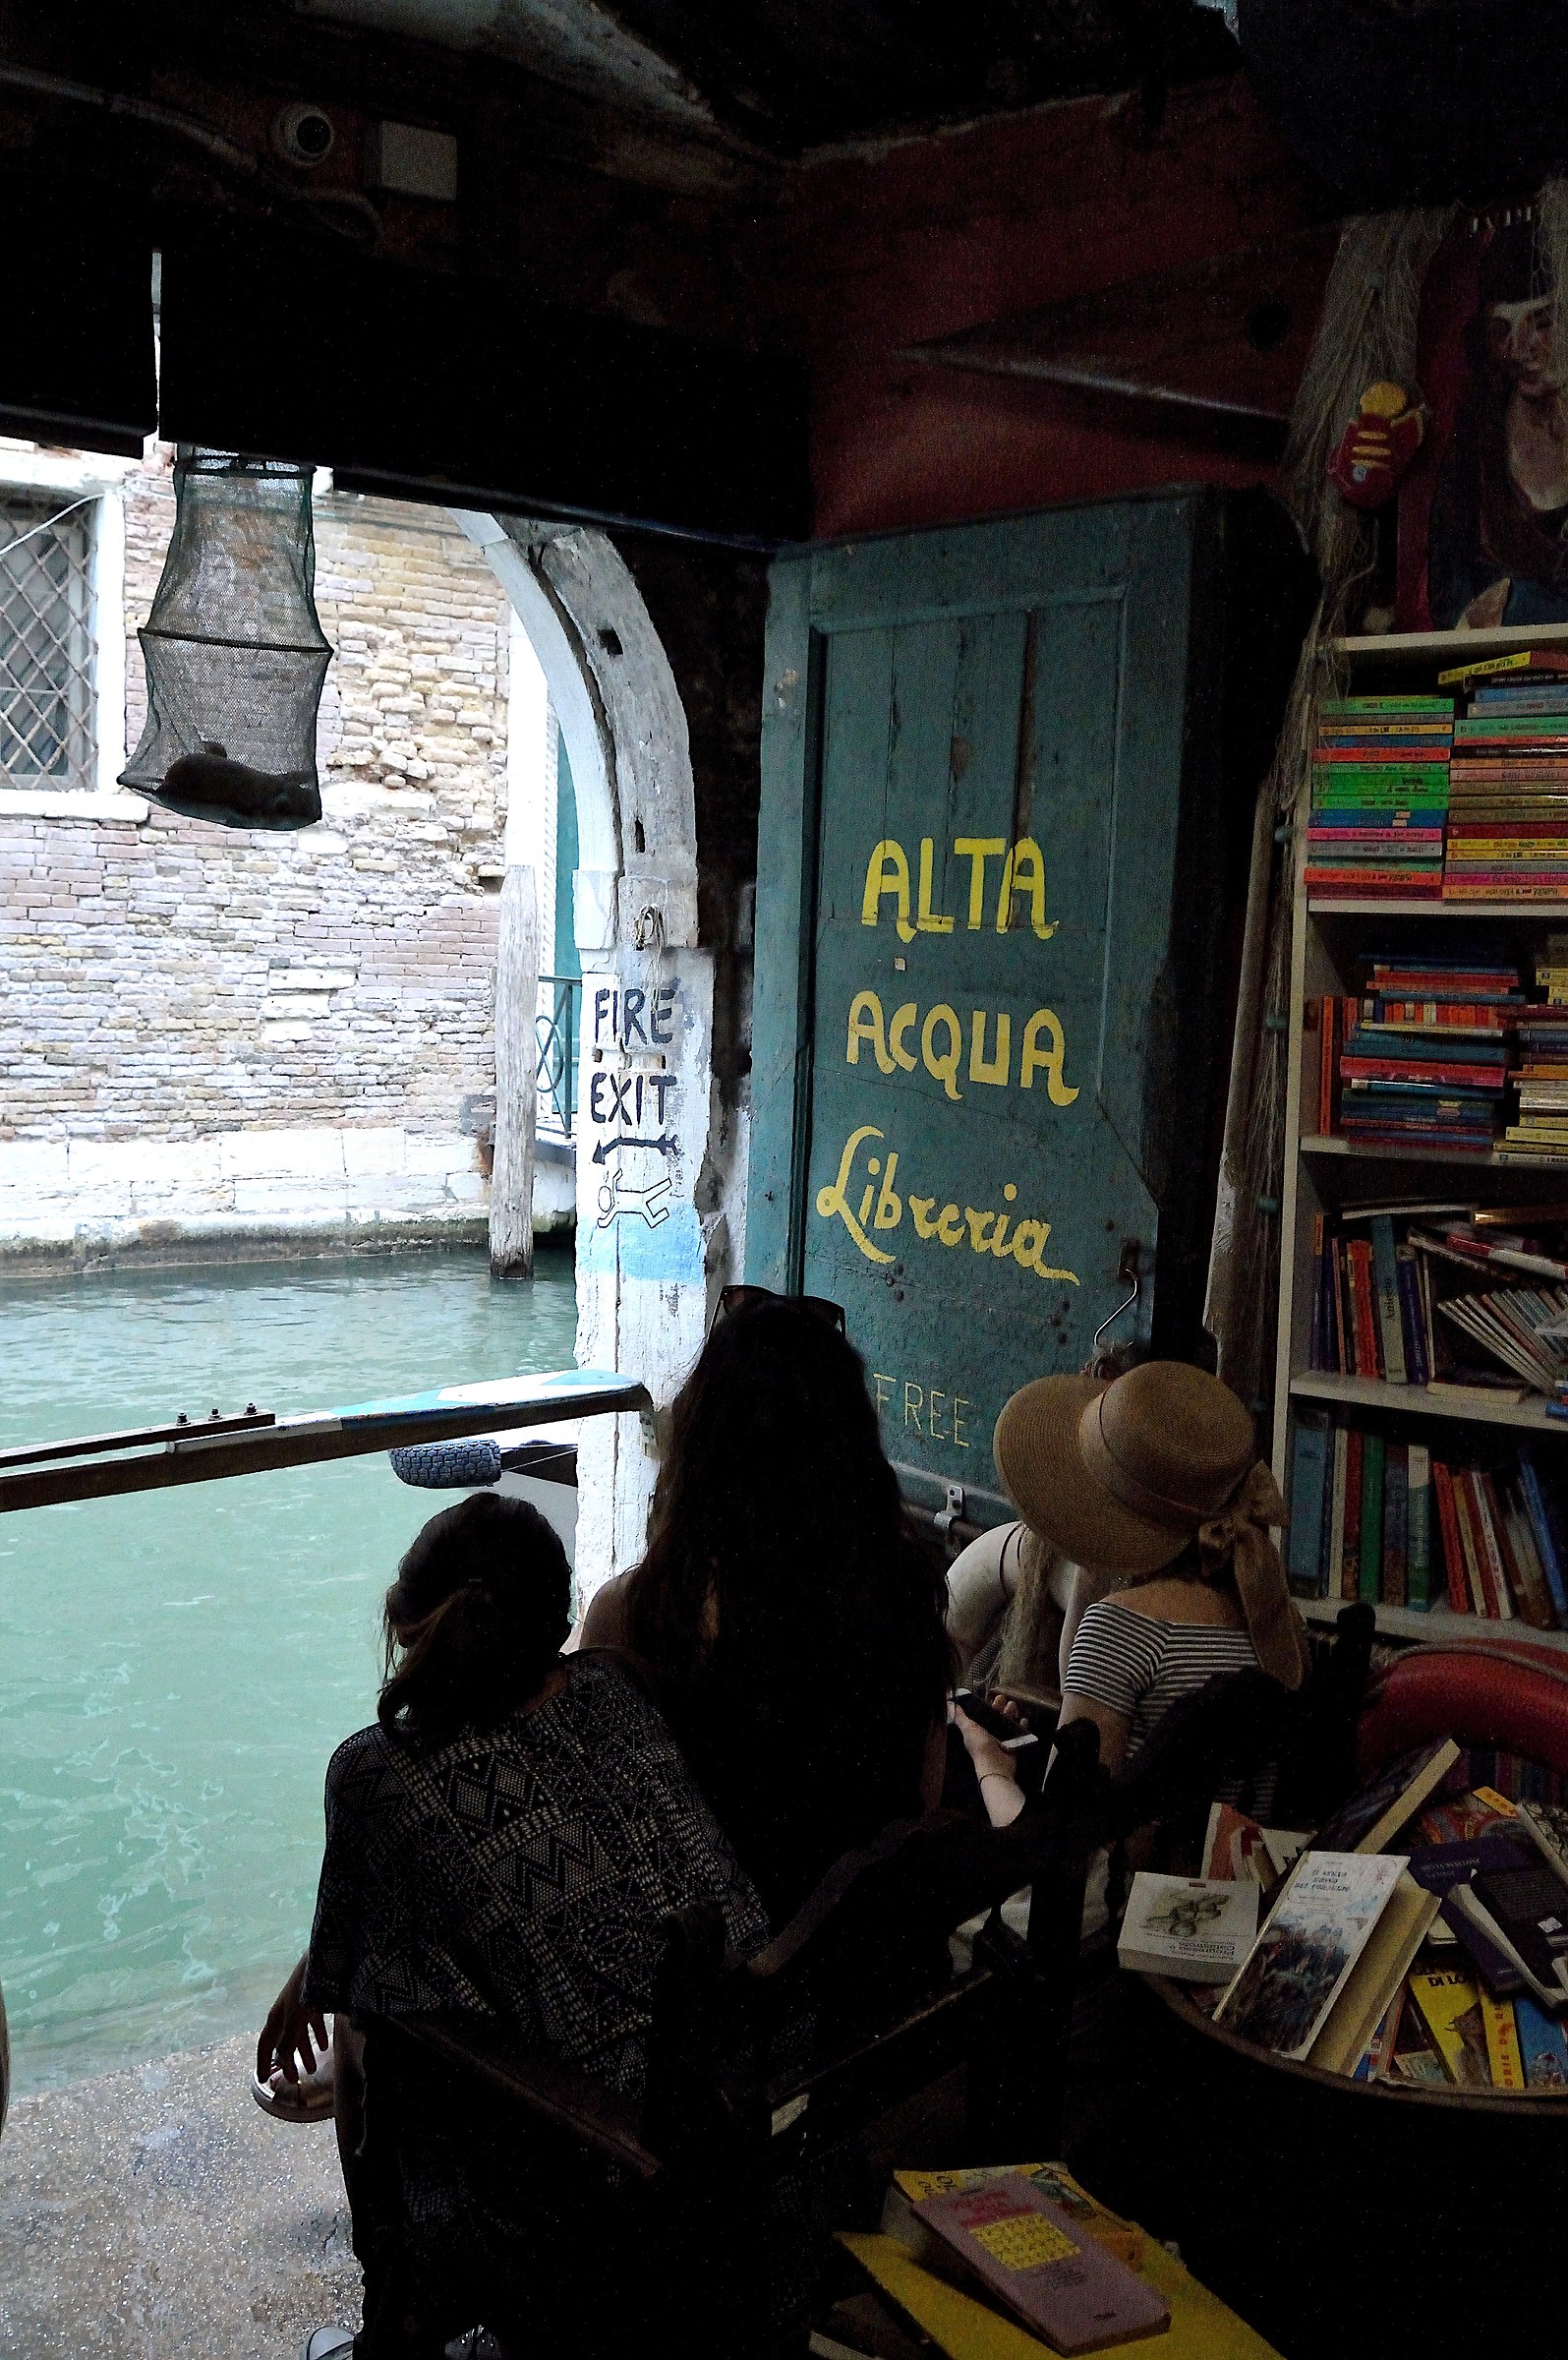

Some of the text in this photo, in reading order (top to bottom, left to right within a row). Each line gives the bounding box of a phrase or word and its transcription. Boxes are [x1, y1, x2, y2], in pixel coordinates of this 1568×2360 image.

[861, 837, 1060, 944] ALTA
[595, 977, 681, 1047] FIRE
[845, 989, 1079, 1107] ACQUA
[590, 1071, 677, 1126] EXIT
[816, 1124, 1080, 1286] Libreria
[873, 1373, 969, 1447] FREE
